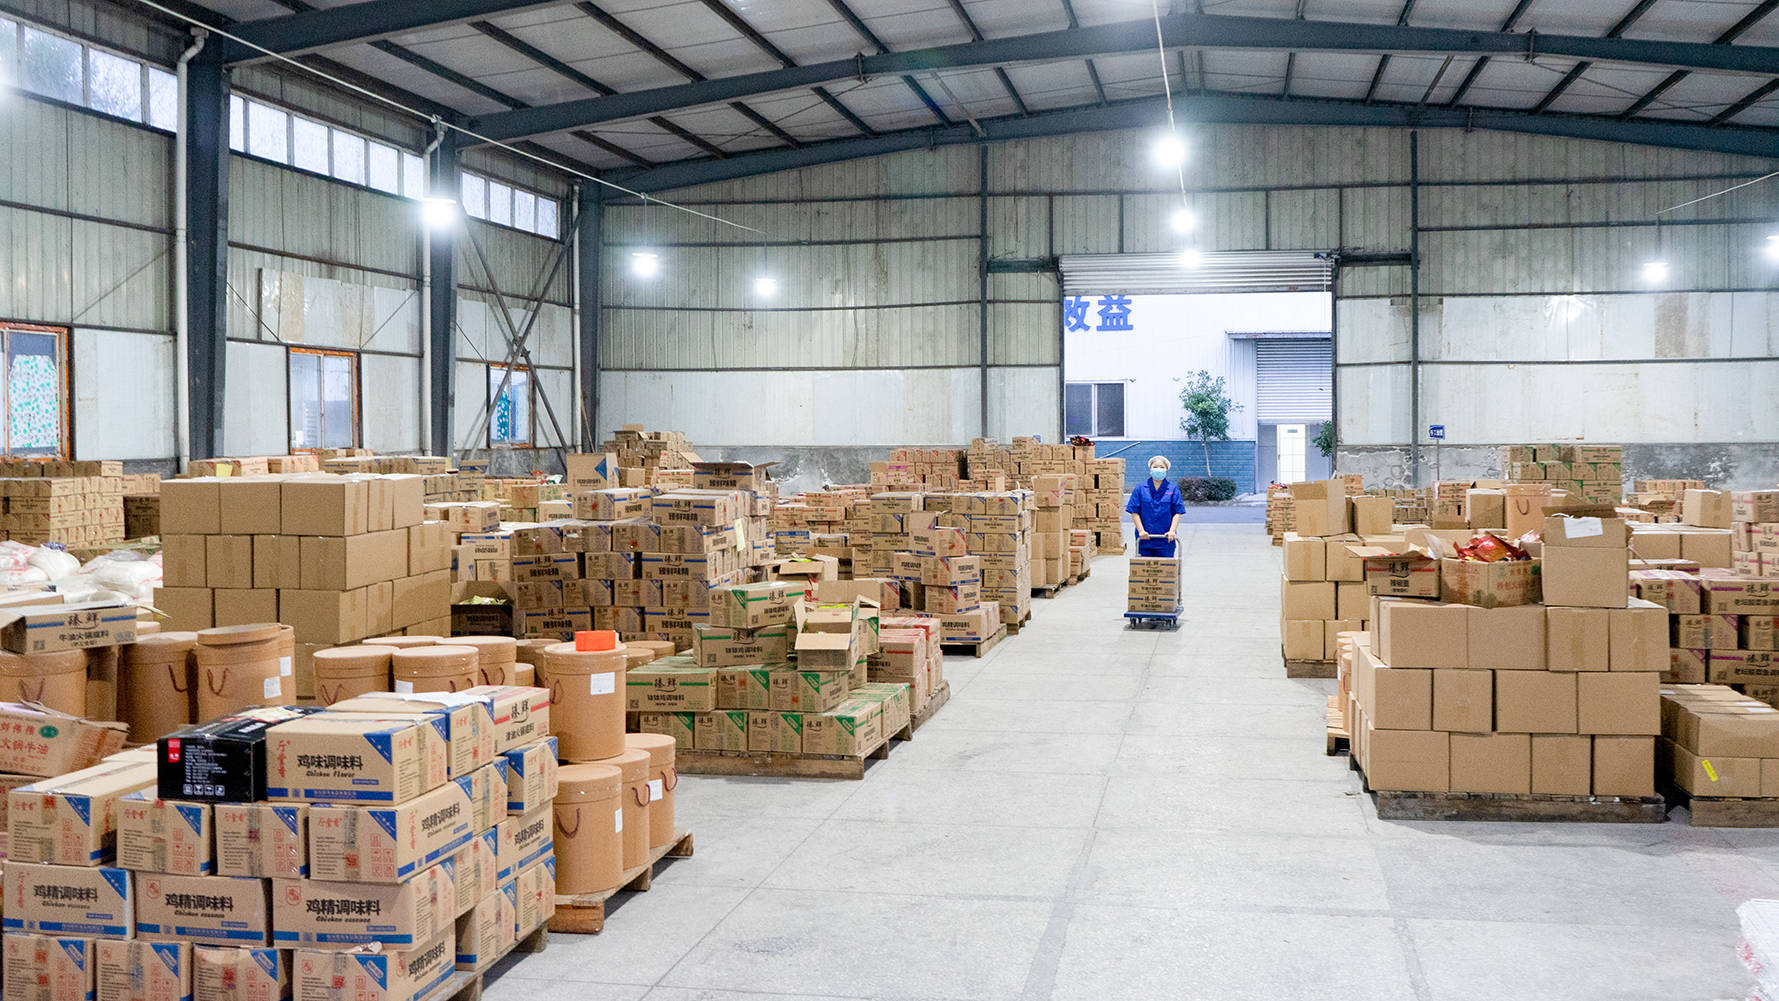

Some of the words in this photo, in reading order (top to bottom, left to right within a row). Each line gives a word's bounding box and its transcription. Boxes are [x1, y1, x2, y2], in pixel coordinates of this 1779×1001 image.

[297, 754, 364, 771] 鸡味调味料
[421, 801, 461, 831] 鸡精调味料
[33, 885, 98, 902] 鸡精调味料
[165, 893, 234, 912] 鸡精调味料
[306, 899, 381, 916] 鸡精调味料
[408, 940, 447, 977] 鸡精调味料
